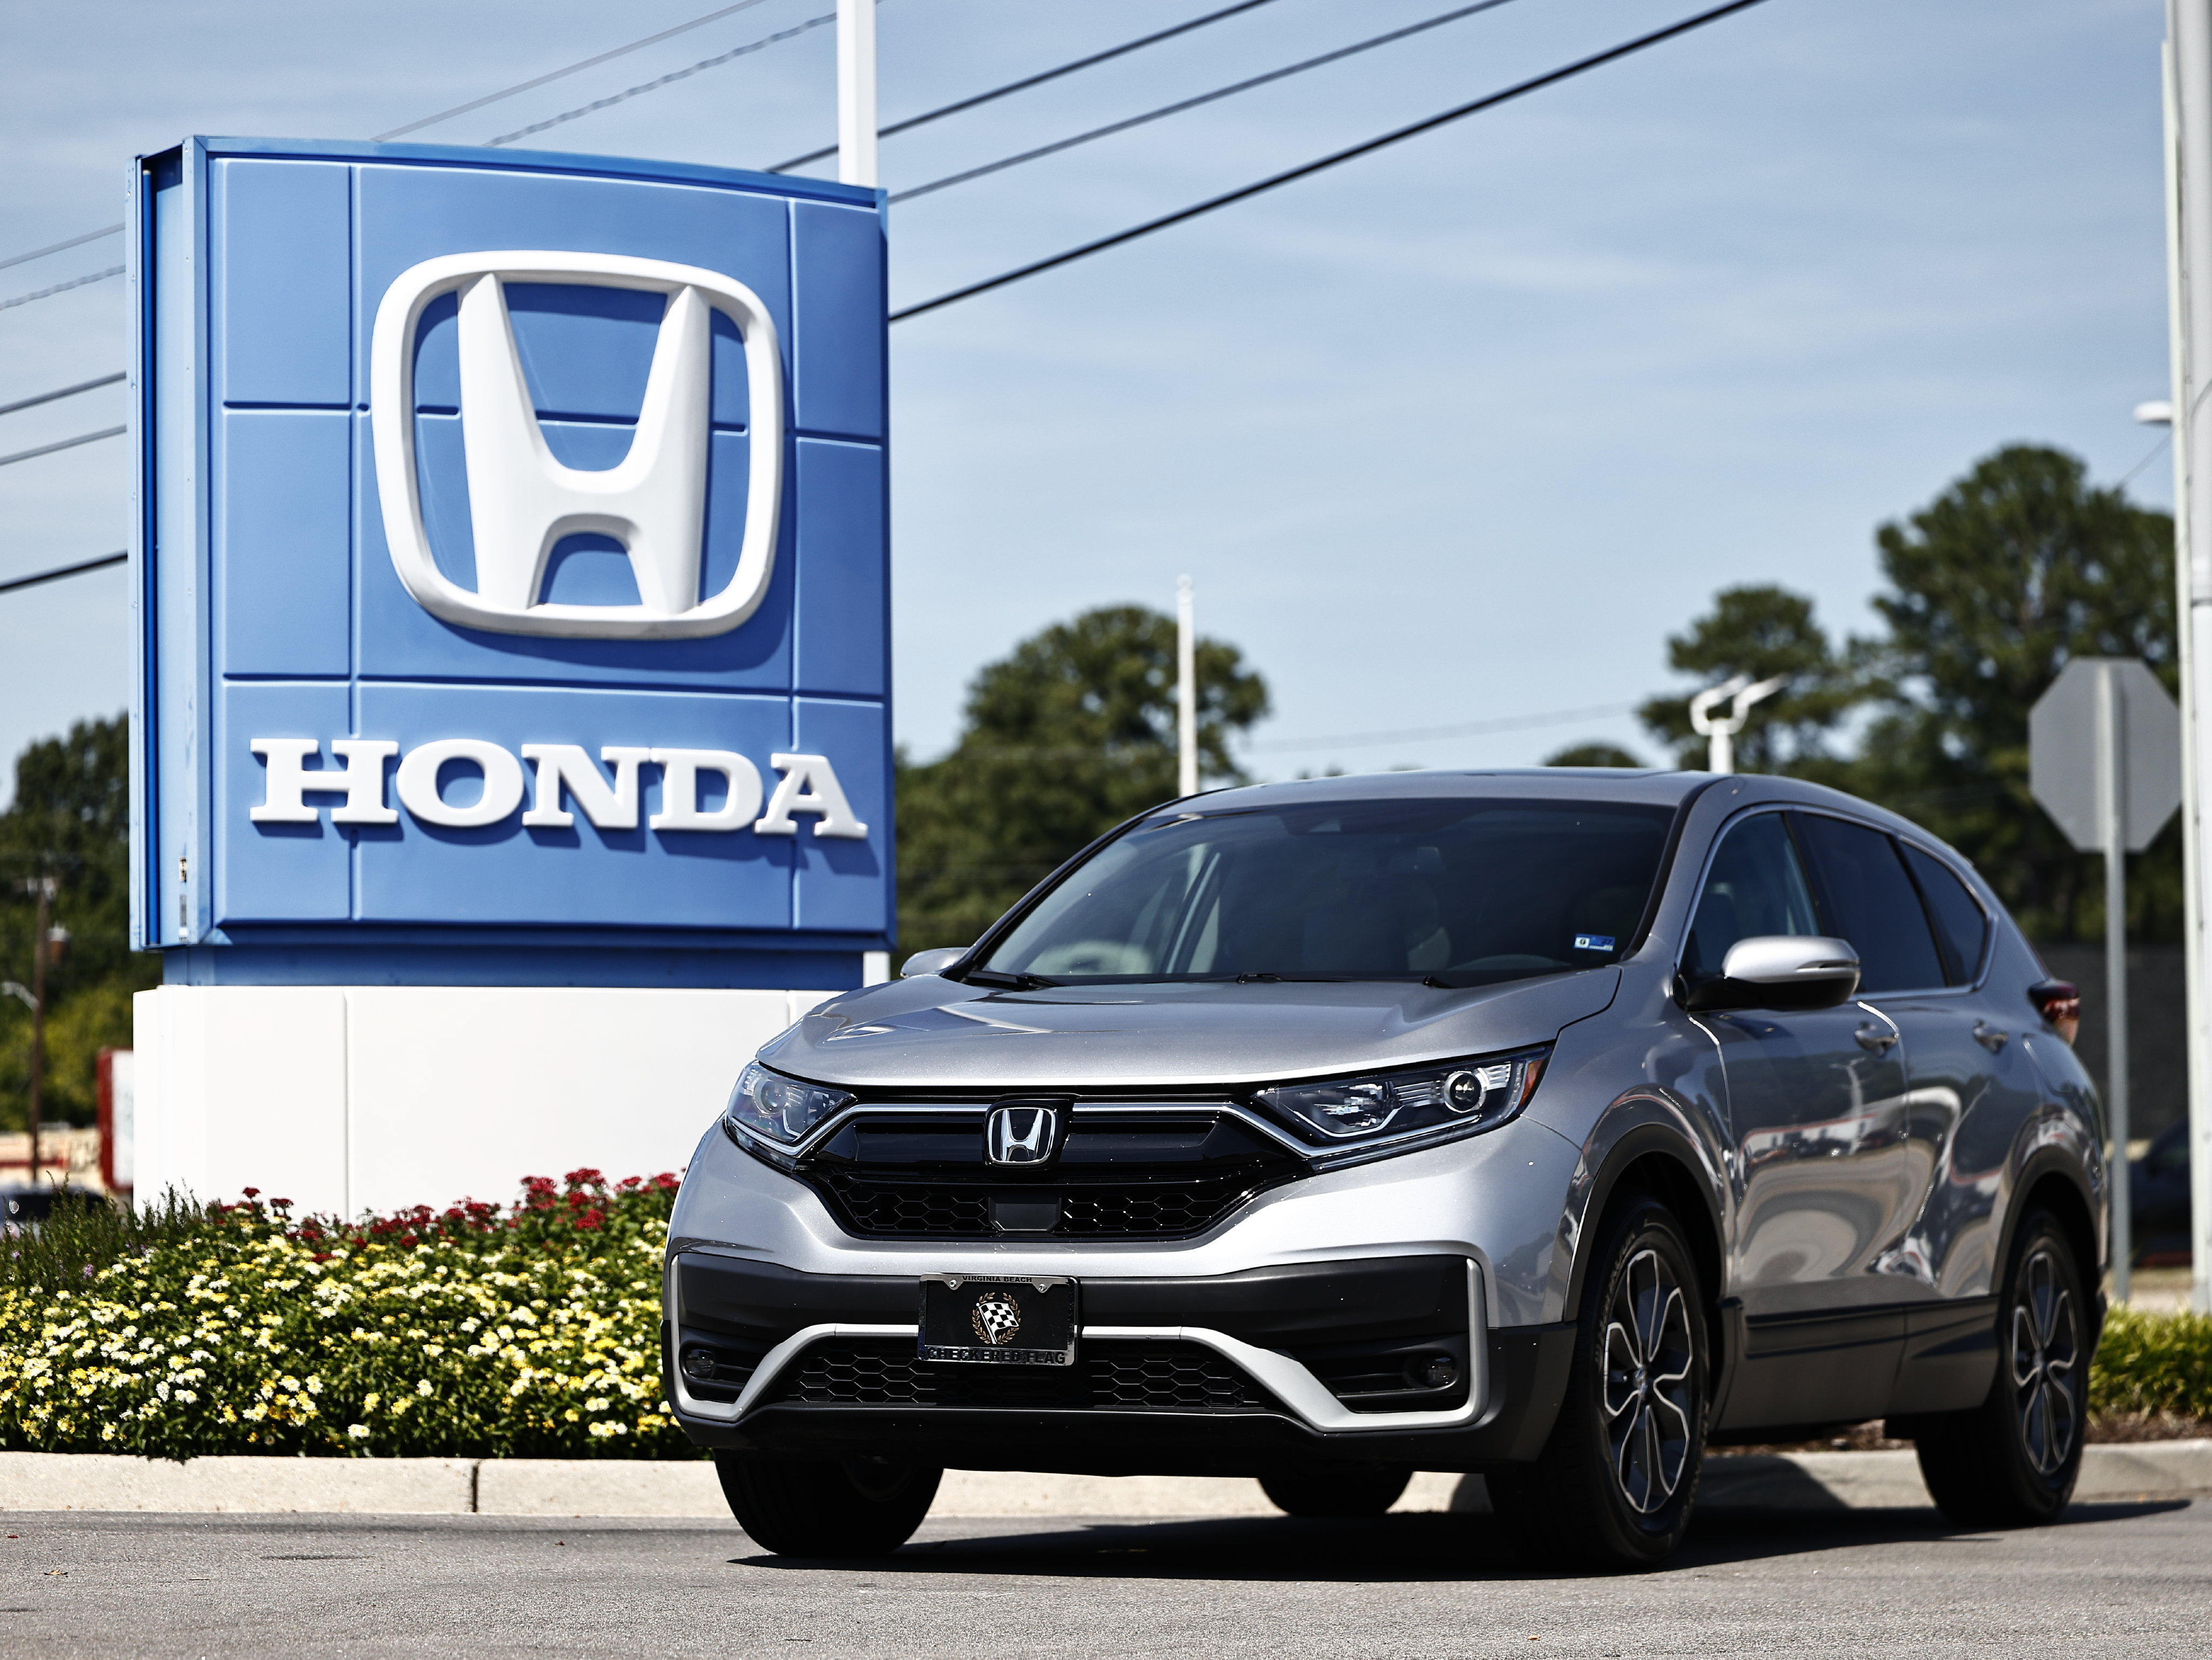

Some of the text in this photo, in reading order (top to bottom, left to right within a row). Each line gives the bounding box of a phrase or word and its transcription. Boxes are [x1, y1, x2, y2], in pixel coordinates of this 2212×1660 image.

[249, 738, 868, 837] HONDA
[927, 1347, 1065, 1364] CHECKERED FLAG
